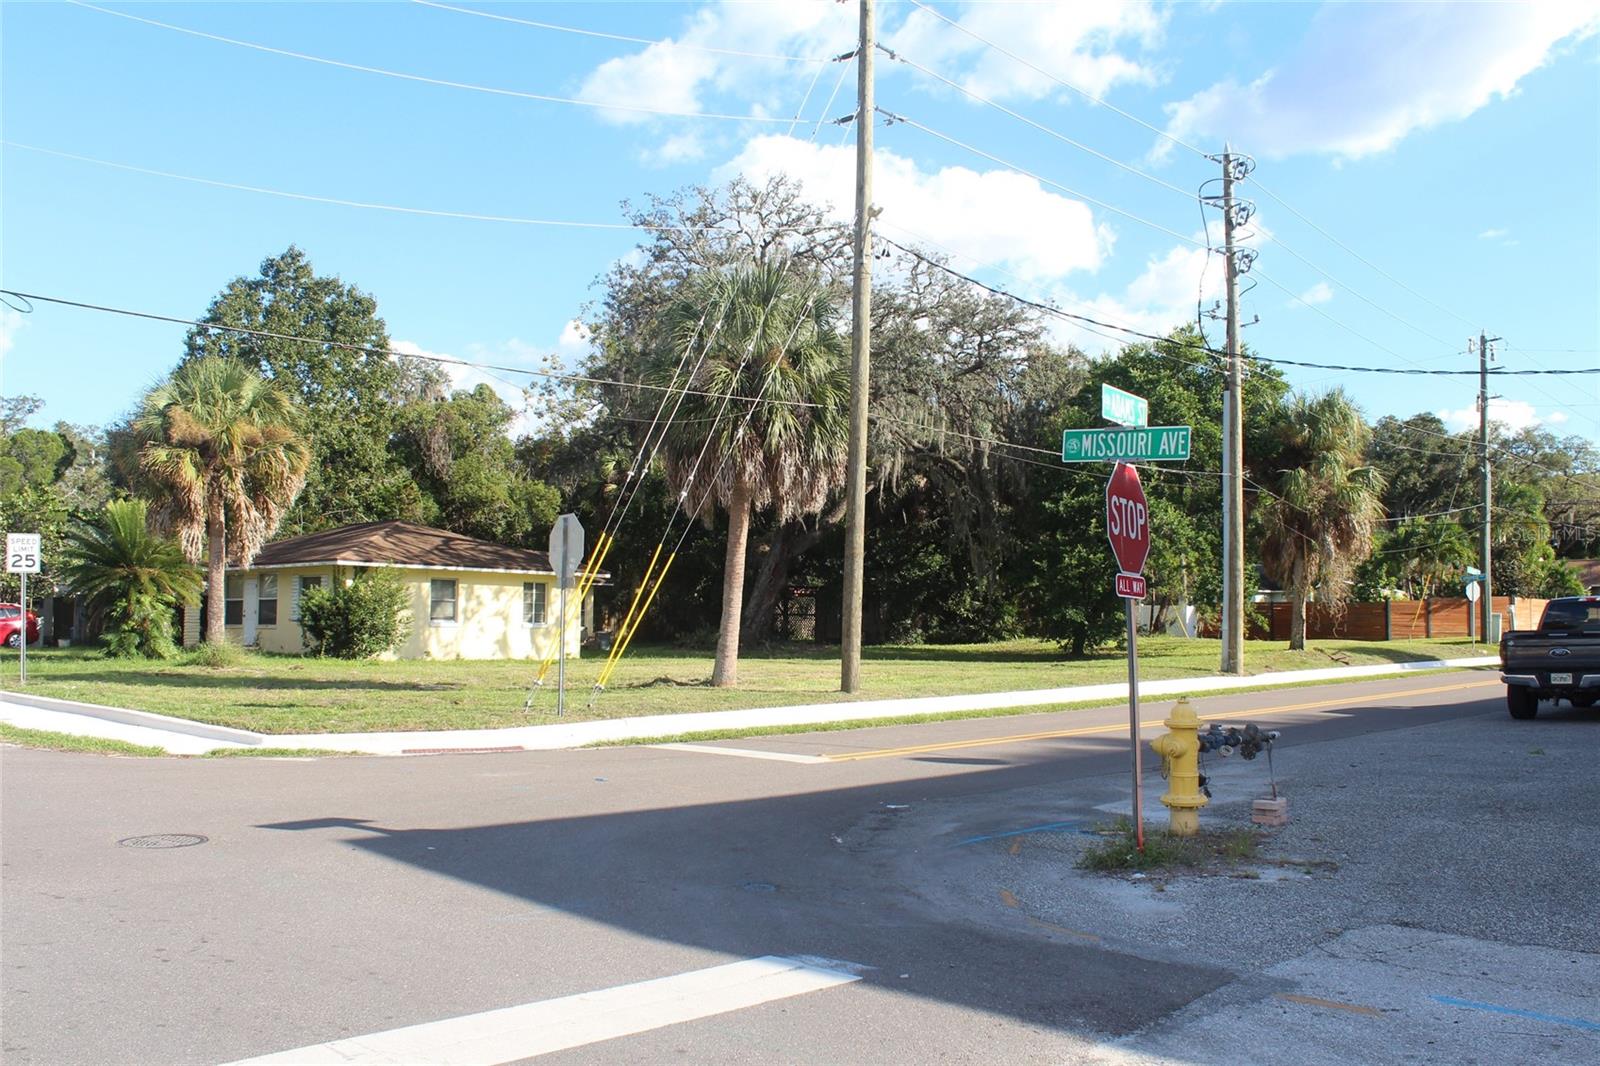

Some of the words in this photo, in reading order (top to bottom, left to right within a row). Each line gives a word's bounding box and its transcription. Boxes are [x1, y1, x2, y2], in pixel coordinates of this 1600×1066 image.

[1111, 393, 1135, 423] ADAMS
[1081, 432, 1152, 457] MISSOURI
[1159, 431, 1186, 455] AVE
[1111, 495, 1146, 541] STOP
[11, 537, 37, 545] SPEED
[11, 554, 36, 568] 25
[1119, 579, 1131, 593] ALL
[1132, 581, 1144, 594] WAY
